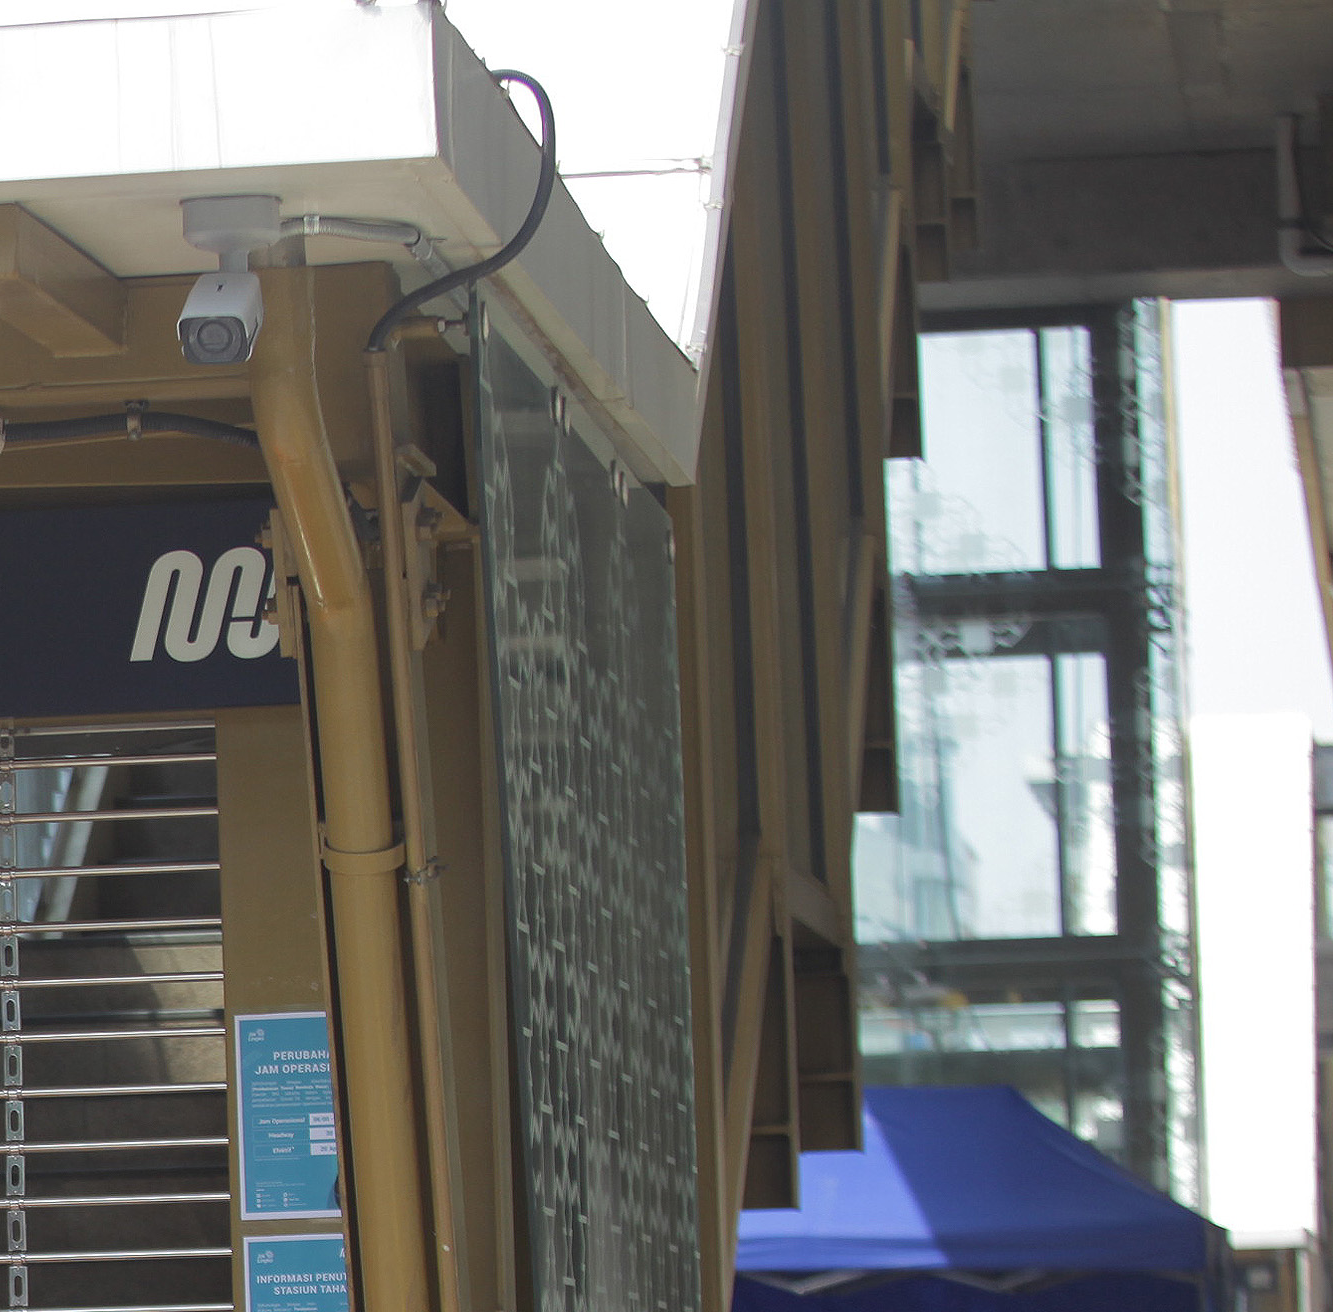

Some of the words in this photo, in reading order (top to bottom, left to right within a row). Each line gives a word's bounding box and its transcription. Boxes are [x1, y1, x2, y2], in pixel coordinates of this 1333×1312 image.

[254, 1064, 279, 1075] JAM
[256, 1273, 313, 1284] INFORMASI
[273, 1285, 318, 1296] STASIUN
